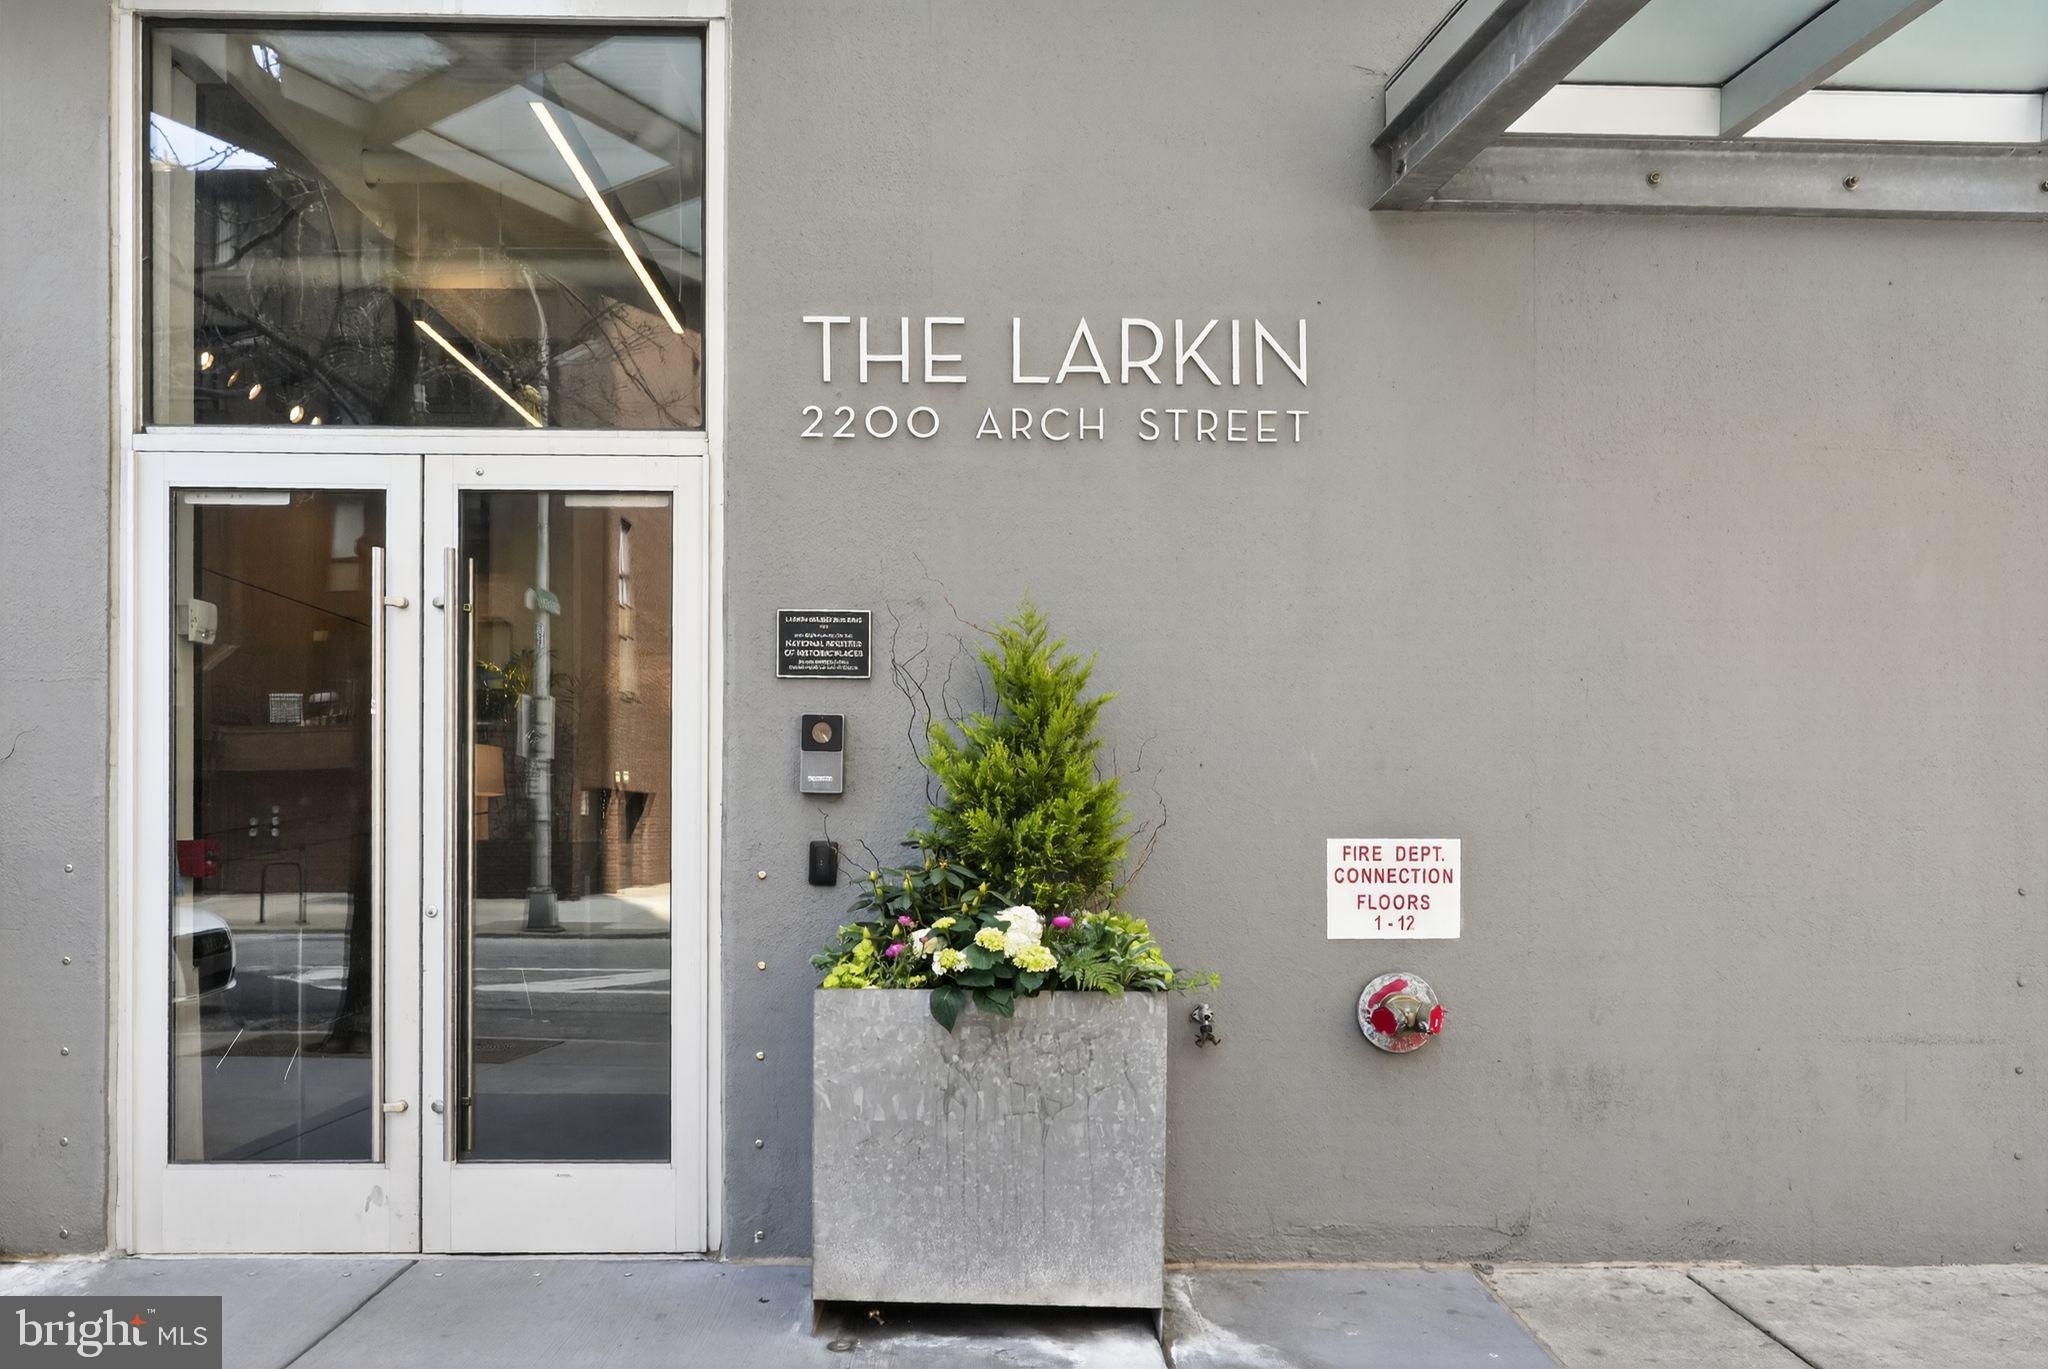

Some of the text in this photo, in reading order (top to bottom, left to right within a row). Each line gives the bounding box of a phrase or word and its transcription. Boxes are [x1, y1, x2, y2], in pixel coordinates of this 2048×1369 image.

[802, 315, 1307, 386] THE LARKIN
[801, 405, 1309, 442] 2200 ARCH STREET
[1342, 845, 1446, 862] FIRE DEPT.
[1334, 867, 1454, 885] CONNECTION
[1357, 894, 1431, 911] FLOORS
